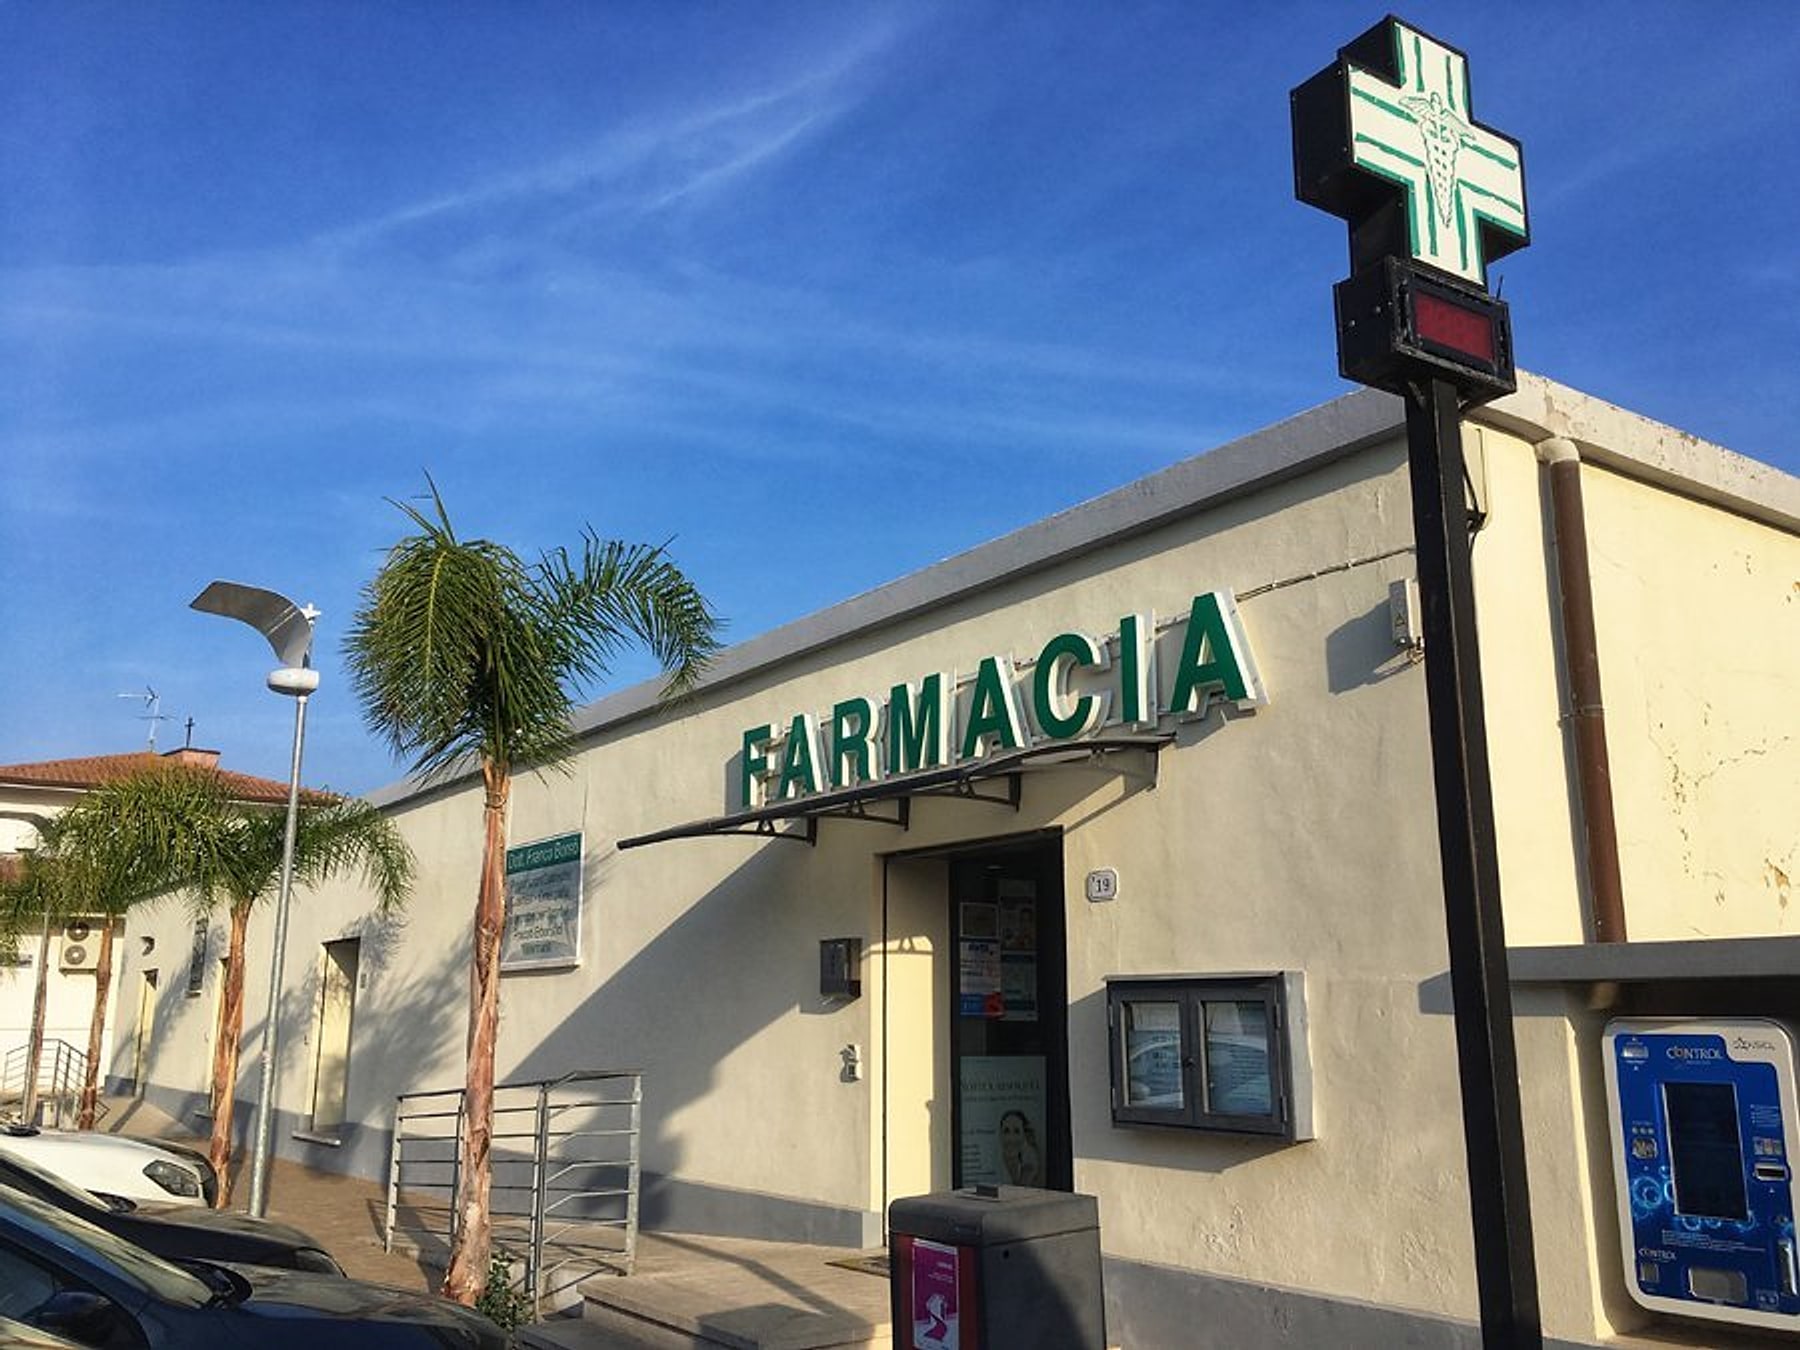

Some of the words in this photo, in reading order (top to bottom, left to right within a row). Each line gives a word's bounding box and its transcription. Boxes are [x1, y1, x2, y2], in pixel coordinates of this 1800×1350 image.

[741, 590, 1264, 807] FARMACIA
[1095, 878, 1110, 892] 19
[1666, 1044, 1723, 1061] CONTROL
